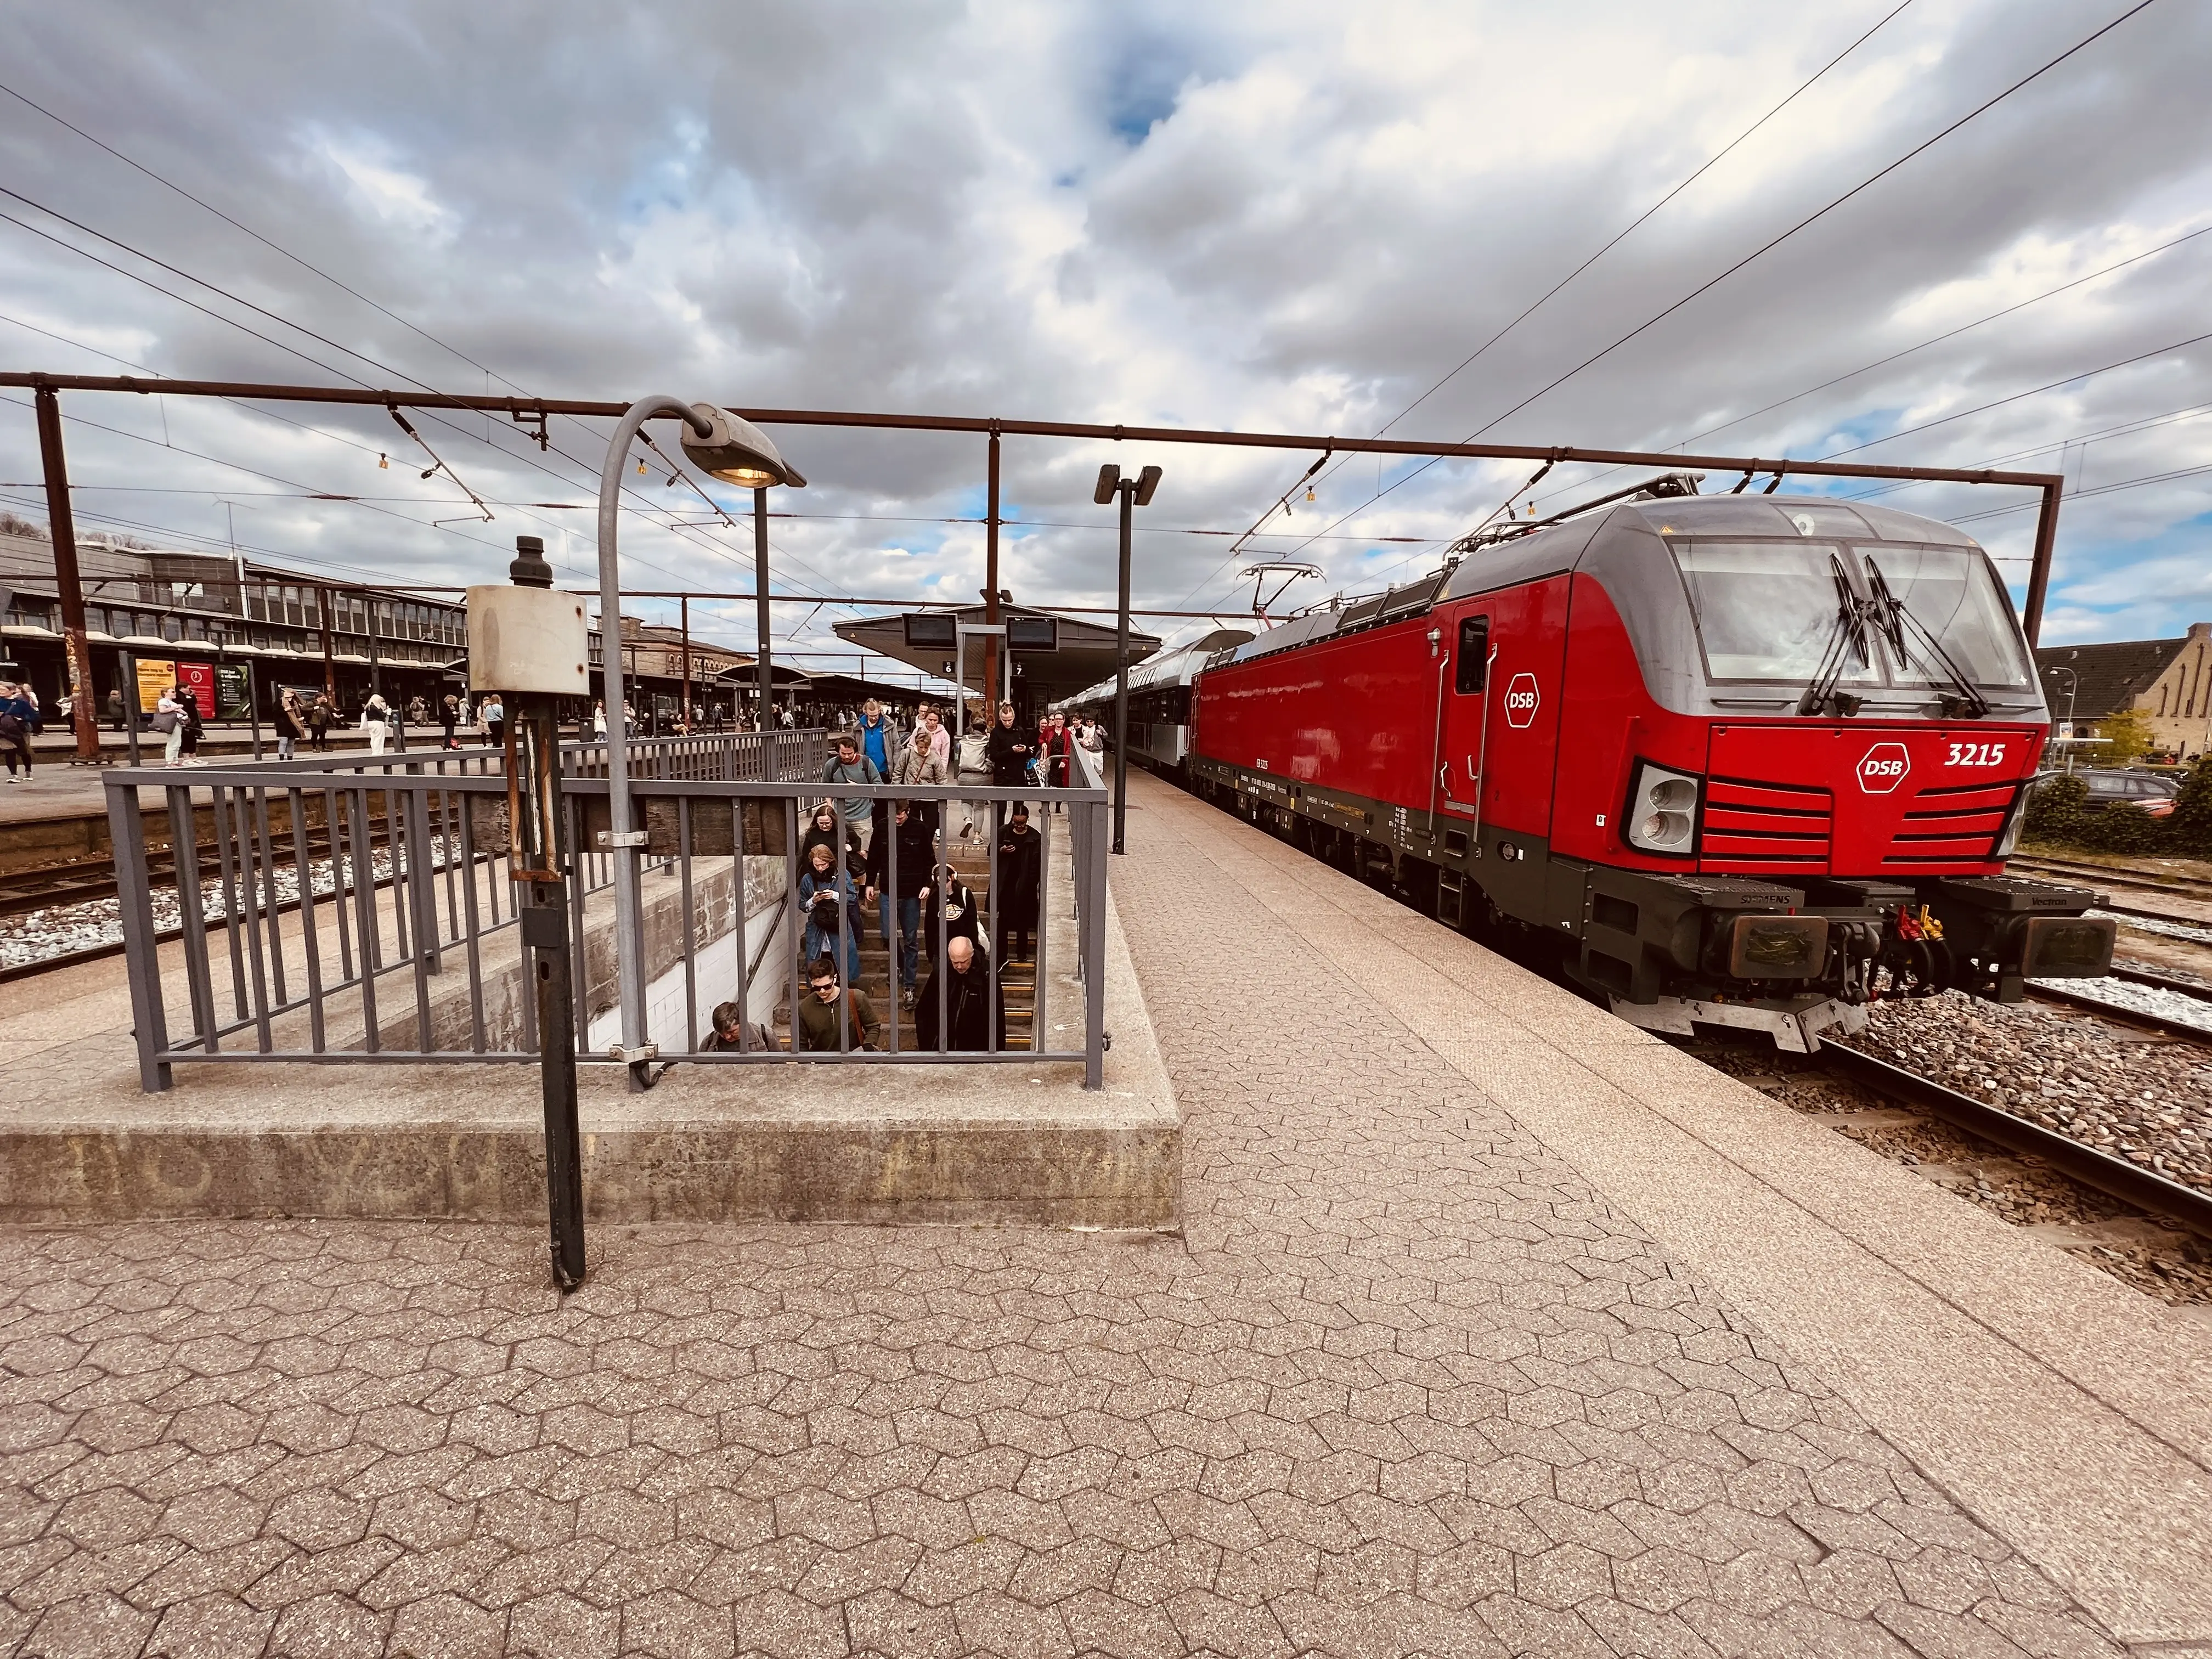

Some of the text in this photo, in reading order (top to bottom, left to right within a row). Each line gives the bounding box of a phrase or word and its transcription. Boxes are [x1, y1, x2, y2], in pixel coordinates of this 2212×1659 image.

[1510, 692, 1534, 708] DSB
[1944, 743, 2006, 766] 3215
[1864, 760, 1904, 775] DSB
[1740, 895, 1791, 904] SIEMENS
[2032, 897, 2067, 906] Vectron
